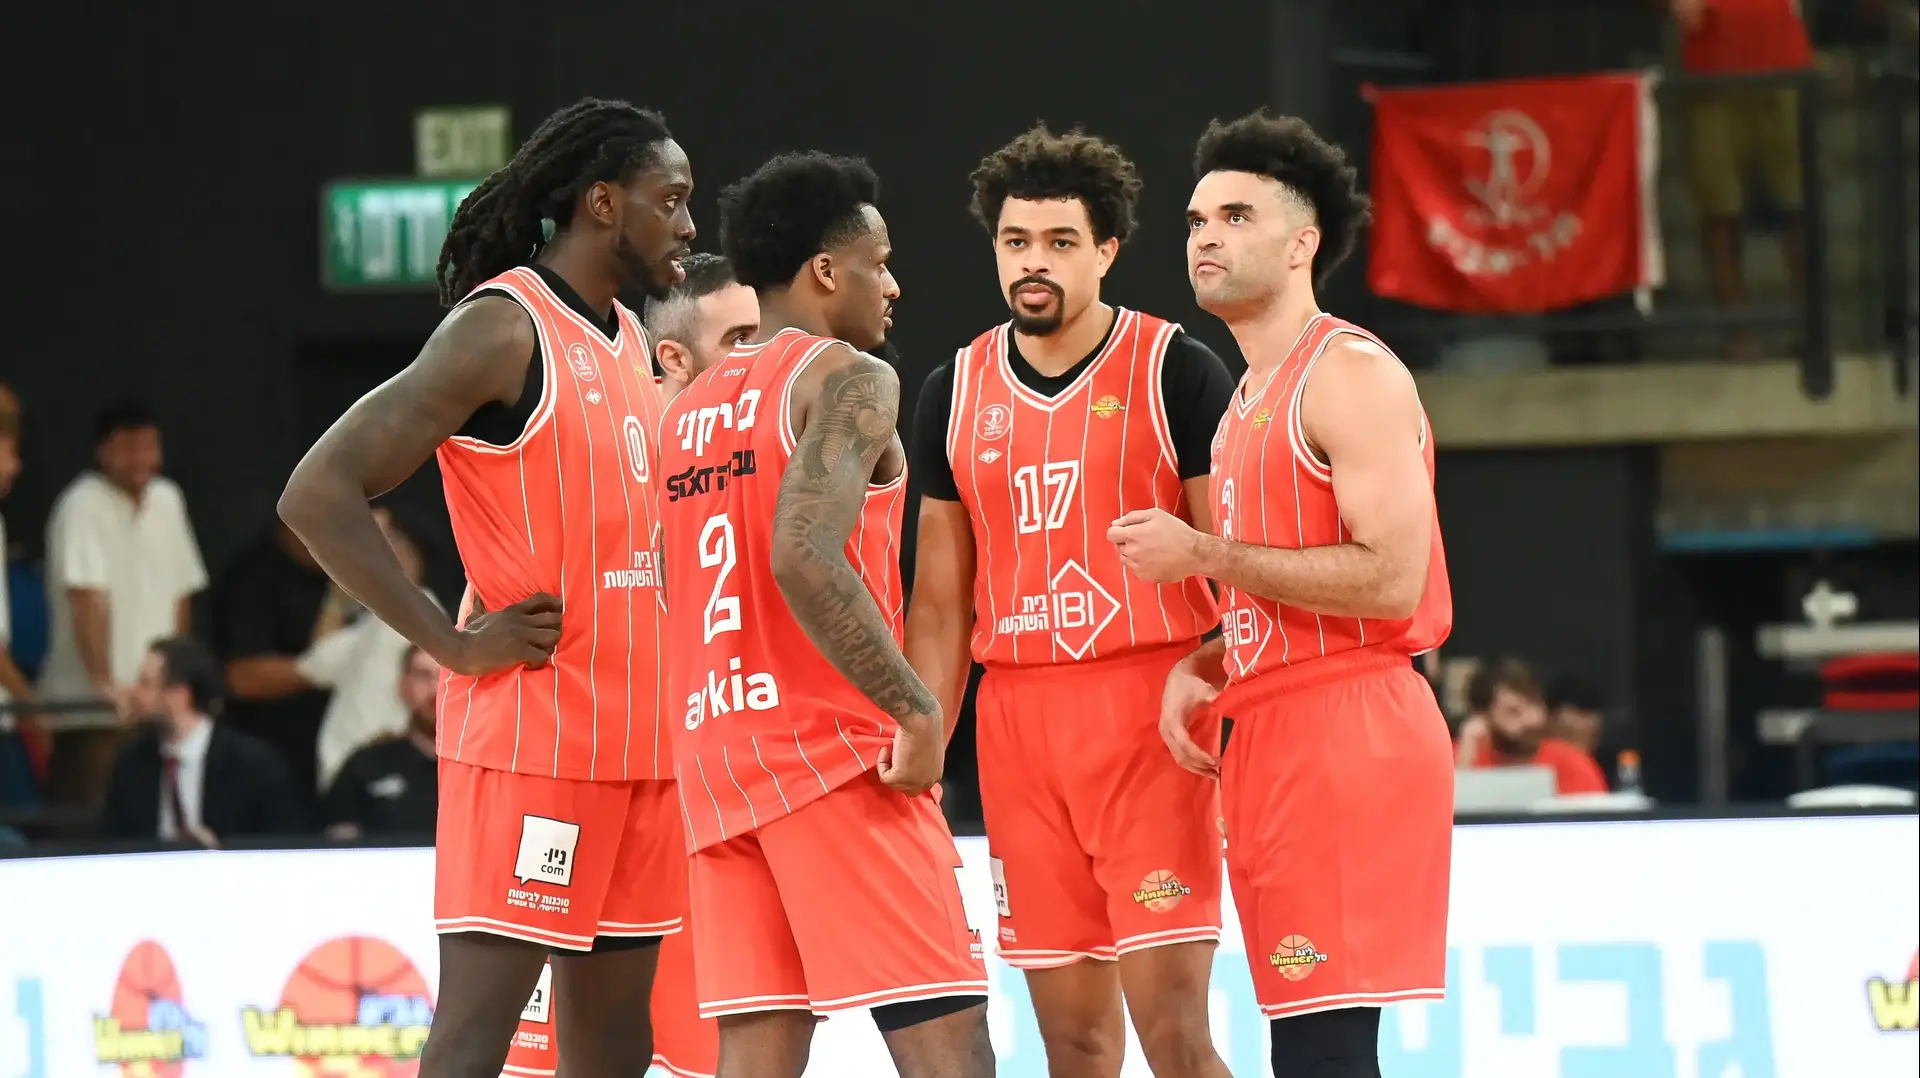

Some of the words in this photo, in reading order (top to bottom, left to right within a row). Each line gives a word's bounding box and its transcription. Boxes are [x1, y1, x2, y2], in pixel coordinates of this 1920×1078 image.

[623, 416, 649, 483] 0
[666, 466, 714, 502] SIXT
[1014, 460, 1079, 535] 17
[633, 551, 652, 568] בית
[603, 570, 655, 590] השקעות
[698, 513, 742, 645] 2
[1022, 594, 1048, 613] בית
[1052, 590, 1095, 629] IBI
[1231, 607, 1259, 647] IBI
[685, 656, 779, 731] arkia
[541, 864, 565, 876] com
[508, 888, 540, 902] לביטוח
[541, 895, 570, 907] סוכנות
[1133, 889, 1179, 903] Winner
[1179, 885, 1191, 895] סל
[1269, 953, 1314, 966] Winner
[1315, 952, 1328, 962] סל
